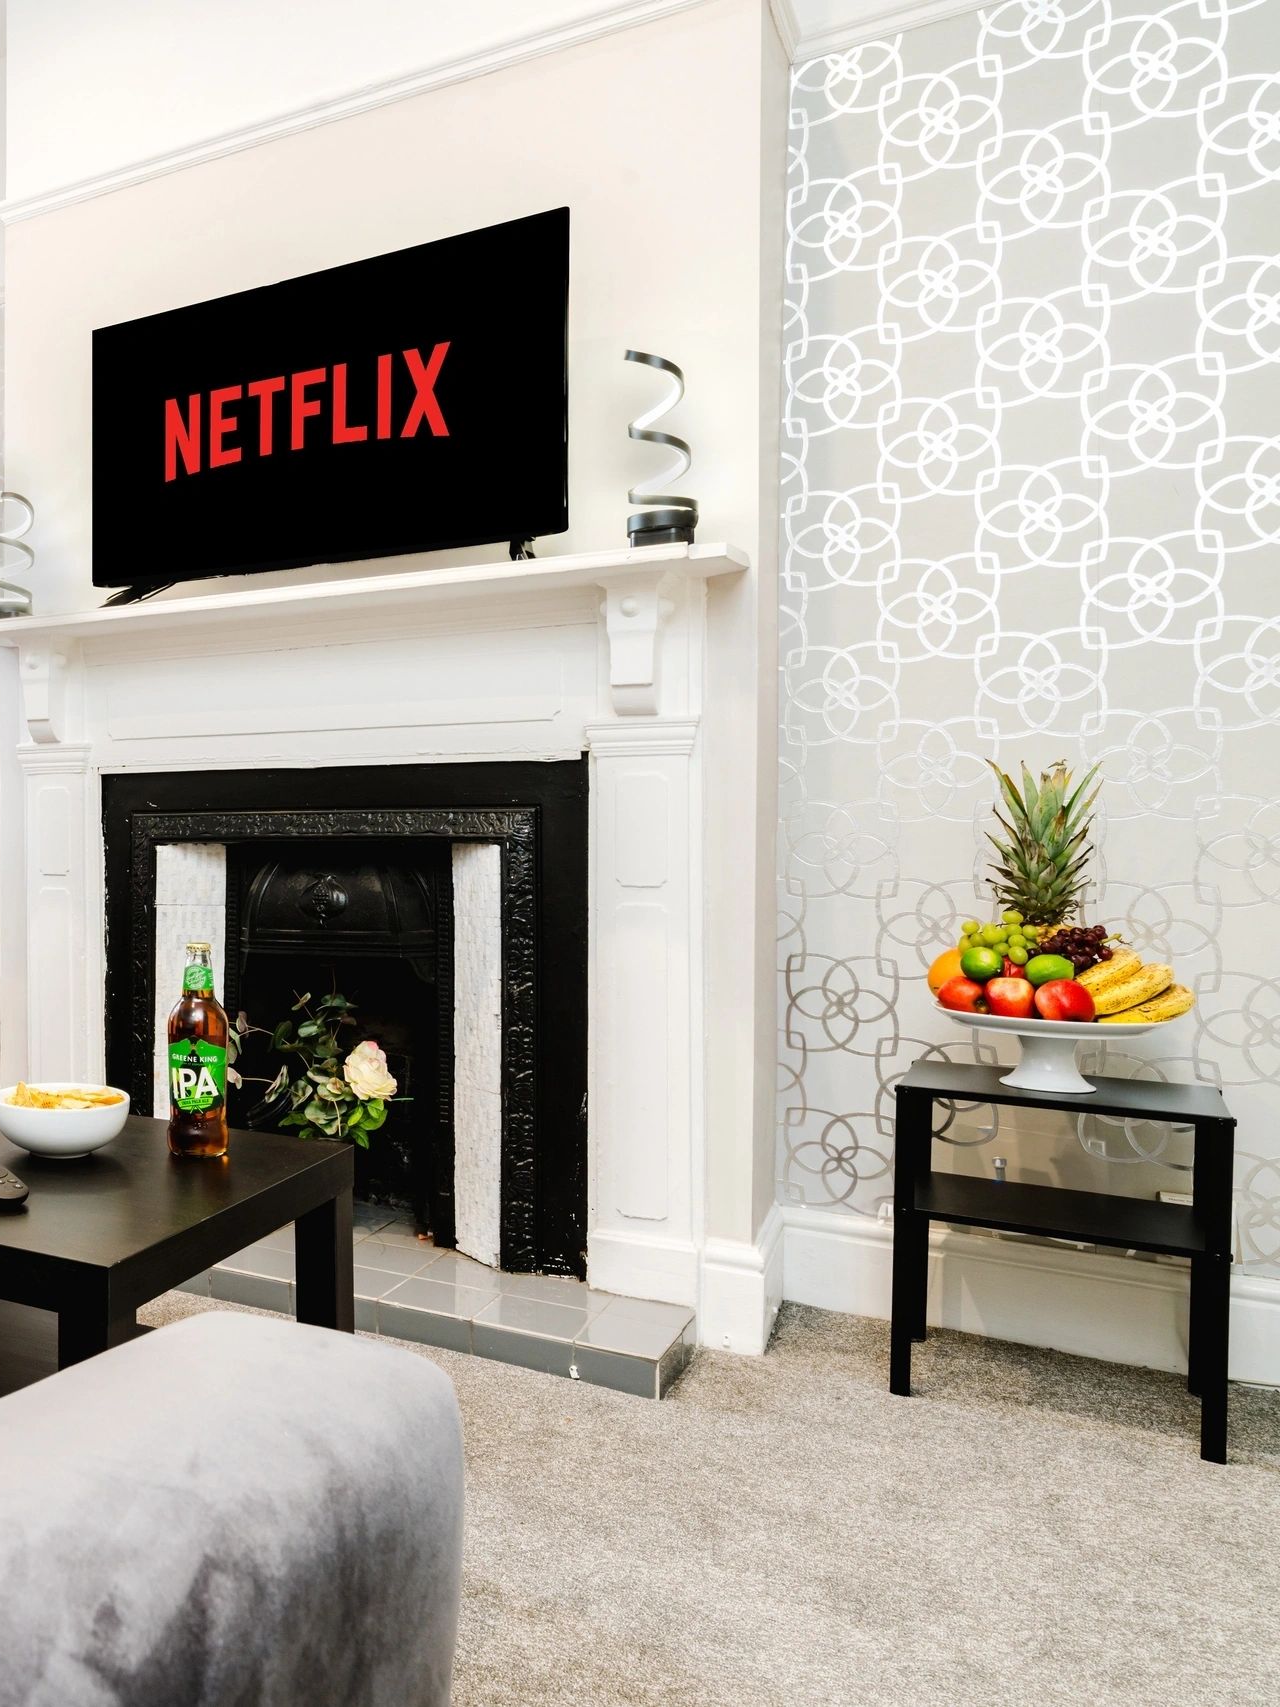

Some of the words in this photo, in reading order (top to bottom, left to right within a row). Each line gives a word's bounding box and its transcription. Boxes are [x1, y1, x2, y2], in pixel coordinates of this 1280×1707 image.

[164, 341, 451, 483] NETFLIX
[172, 1053, 198, 1062] GREENE
[172, 1067, 219, 1099] IPA
